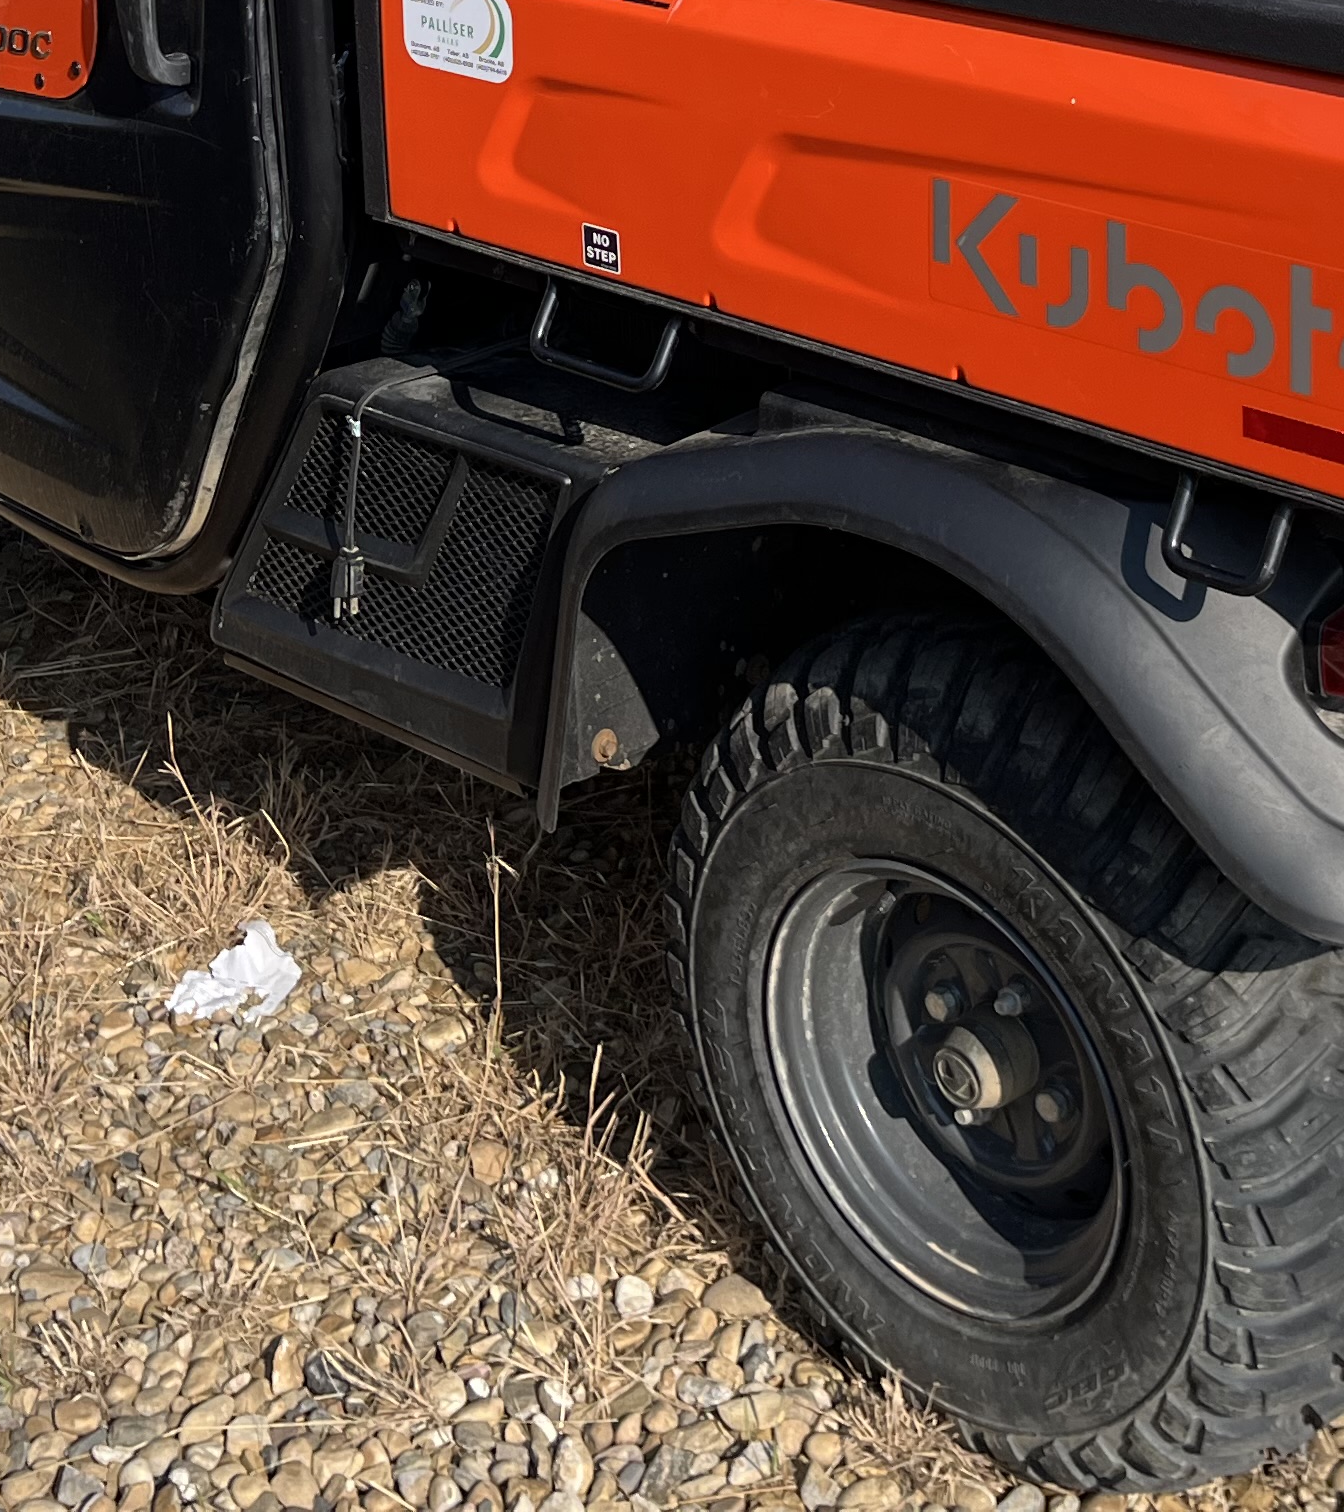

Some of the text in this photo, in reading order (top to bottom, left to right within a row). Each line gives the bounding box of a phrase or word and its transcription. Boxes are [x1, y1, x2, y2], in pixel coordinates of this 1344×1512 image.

[421, 14, 474, 39] PALLISER
[592, 232, 610, 248] NO
[586, 245, 617, 264] STEP
[1008, 866, 1185, 1156] KANATI
